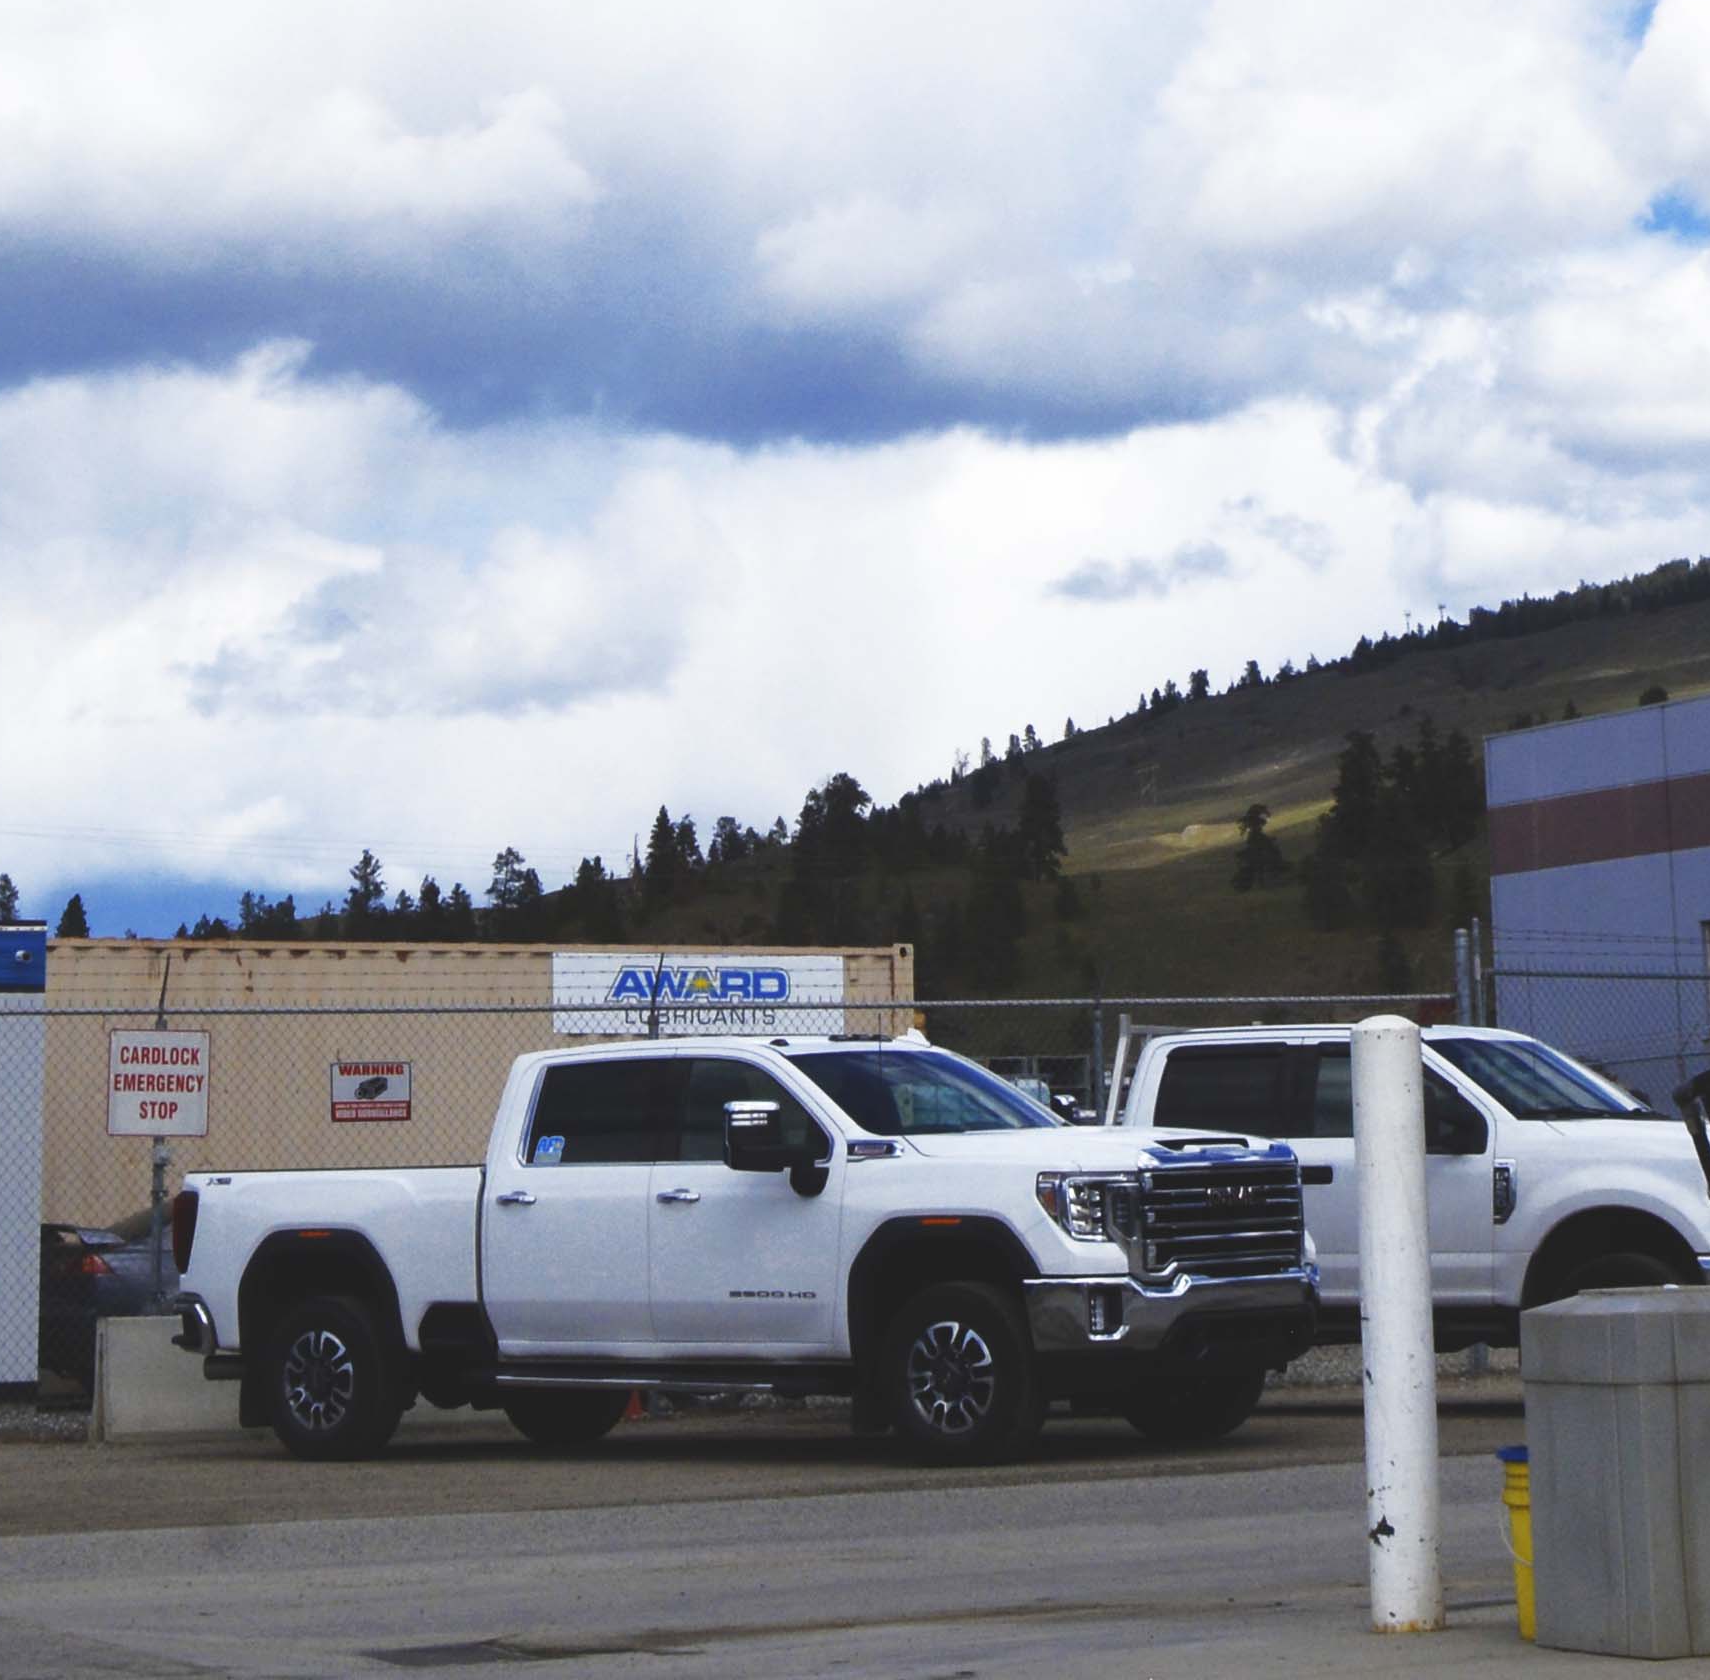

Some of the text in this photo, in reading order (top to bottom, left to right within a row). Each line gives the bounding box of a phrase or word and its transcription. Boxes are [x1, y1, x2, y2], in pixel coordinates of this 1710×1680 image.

[608, 967, 789, 1002] AWARD
[625, 1007, 776, 1025] LUBRICANTS
[120, 1046, 200, 1065] CARDLOCK
[339, 1063, 404, 1076] WARNING
[114, 1073, 204, 1093] EMERGENCY
[139, 1101, 178, 1120] STOP
